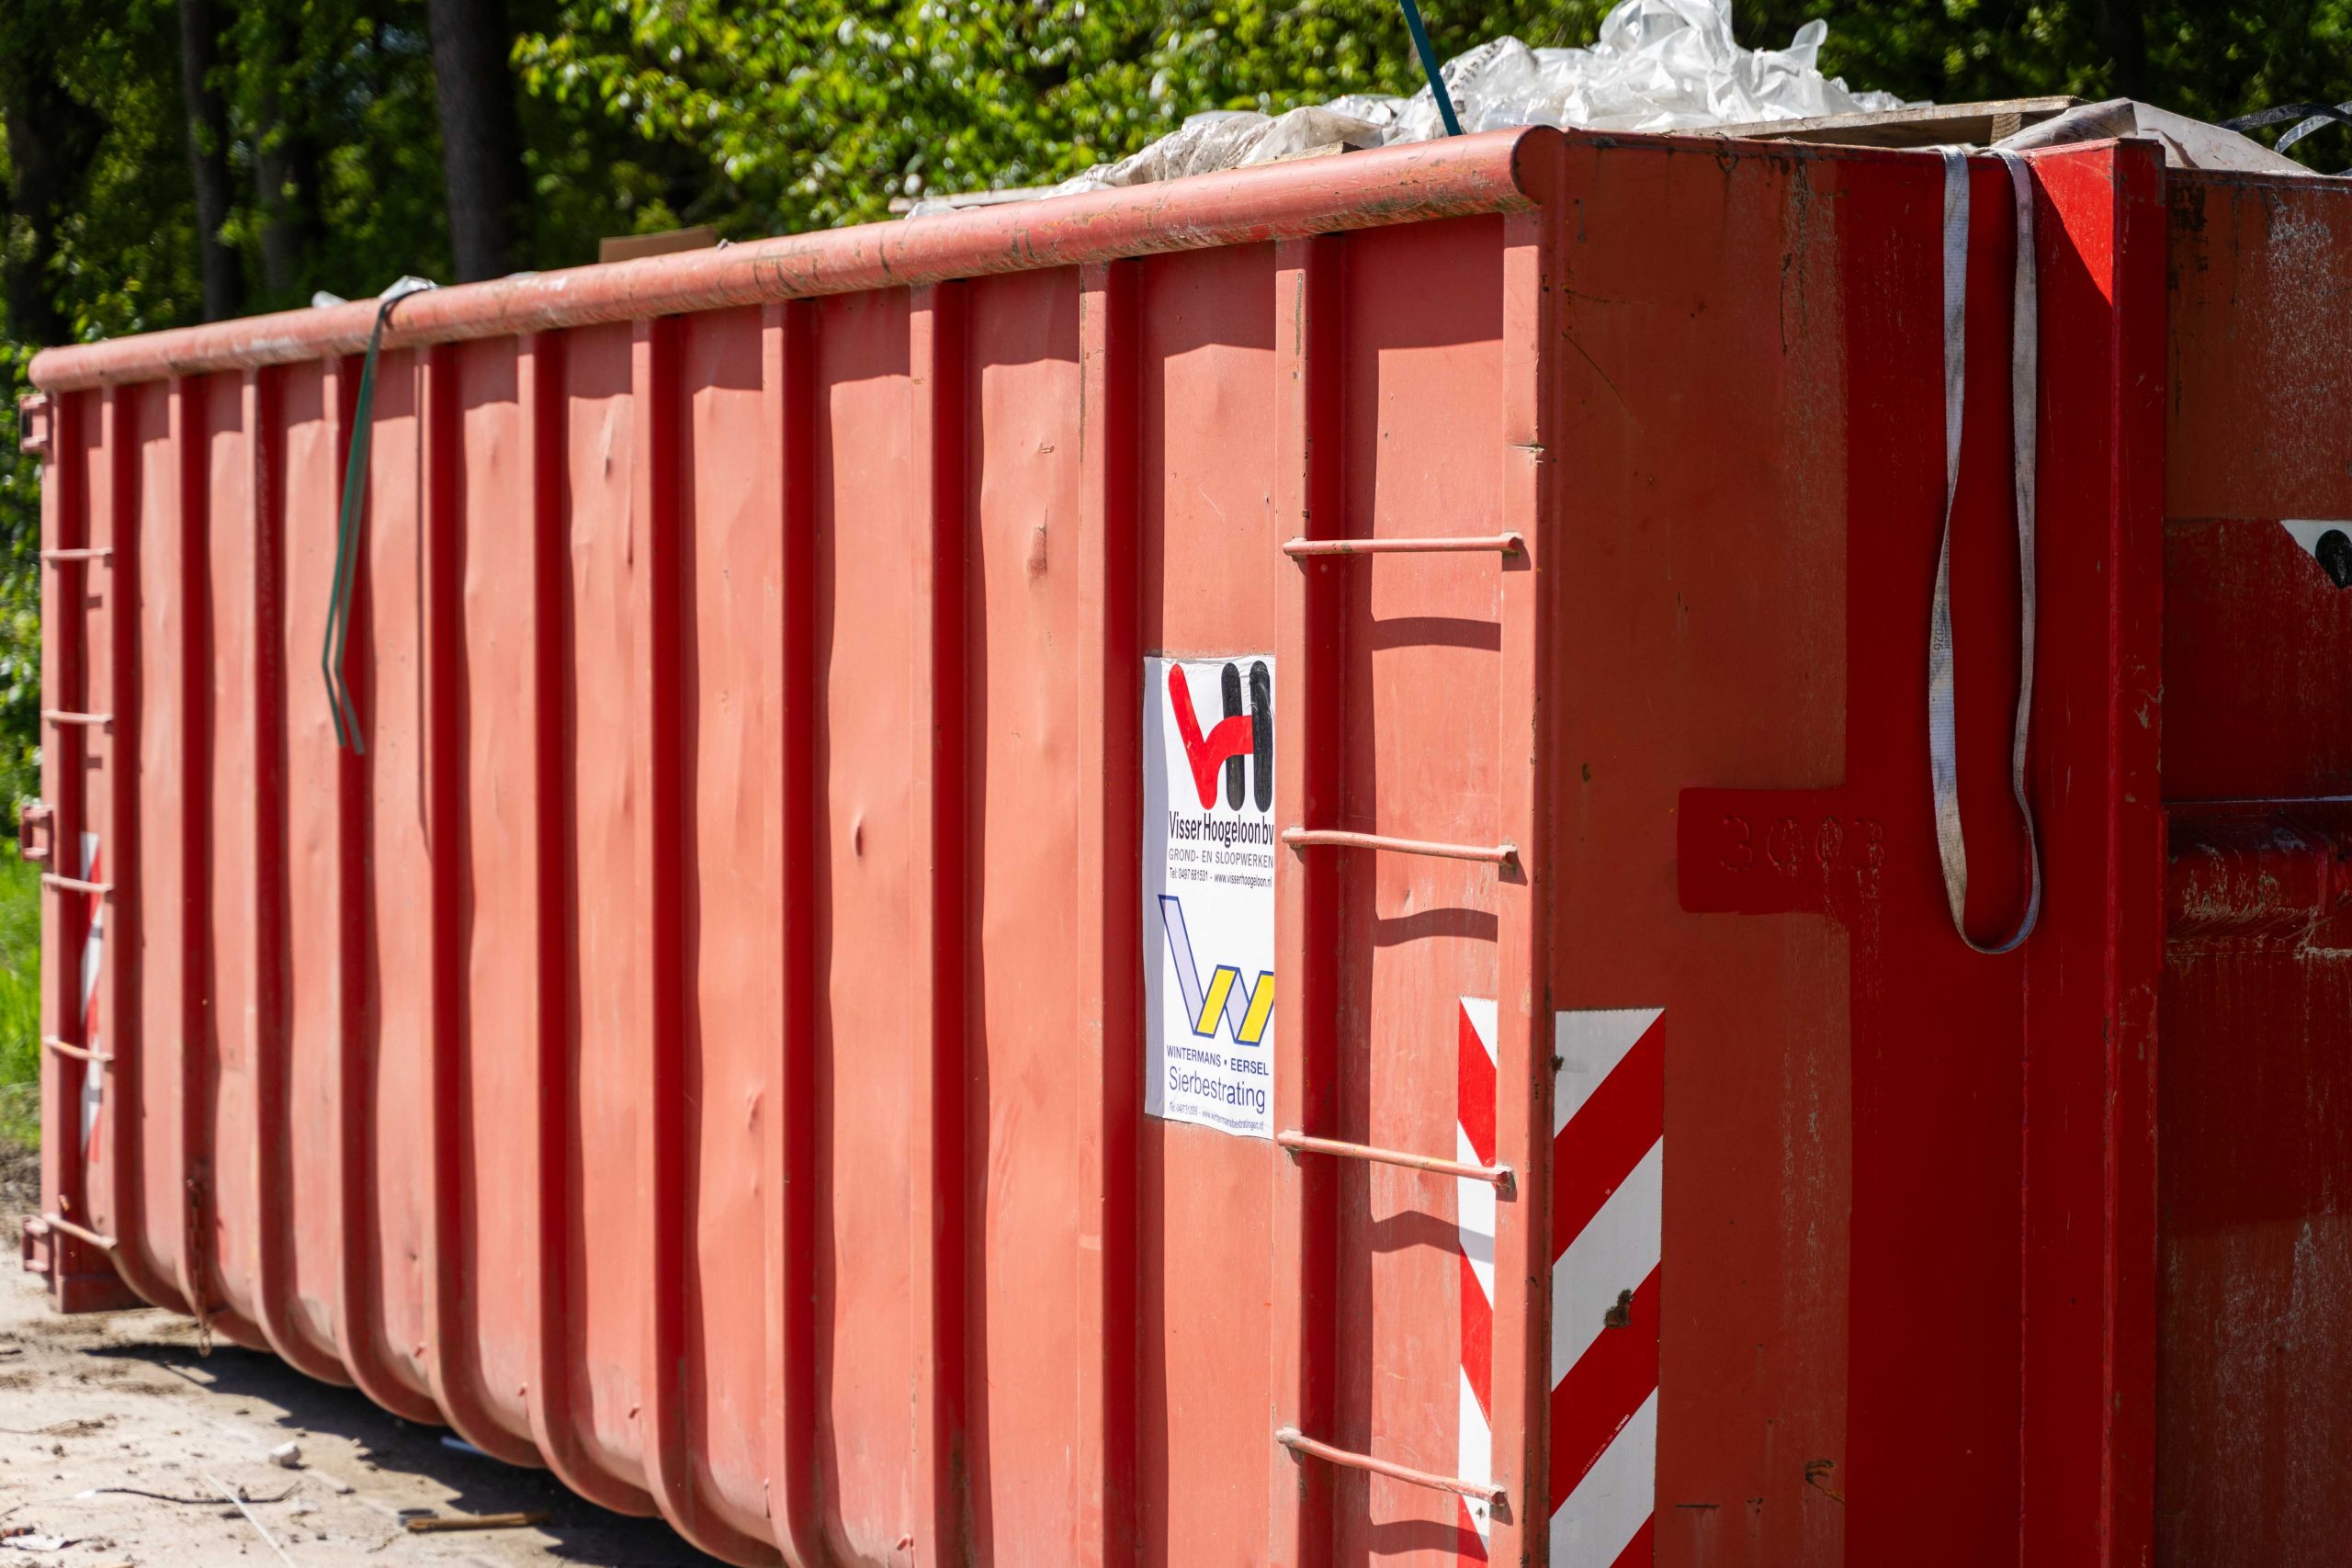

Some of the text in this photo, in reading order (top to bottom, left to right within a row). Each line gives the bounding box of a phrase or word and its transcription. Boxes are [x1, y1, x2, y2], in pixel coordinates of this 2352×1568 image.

[1170, 811, 1274, 849] Visser Hoogeloon bv
[1169, 848, 1273, 869] GROND- EN SLOOPWERKEN
[1178, 868, 1191, 880] 0497
[1215, 872, 1272, 888] www.visserhoogeloon.nl
[1166, 1044, 1221, 1067] WINTERMANS
[1230, 1057, 1269, 1076] EERSEL
[1169, 1066, 1265, 1114] Sierbestrating
